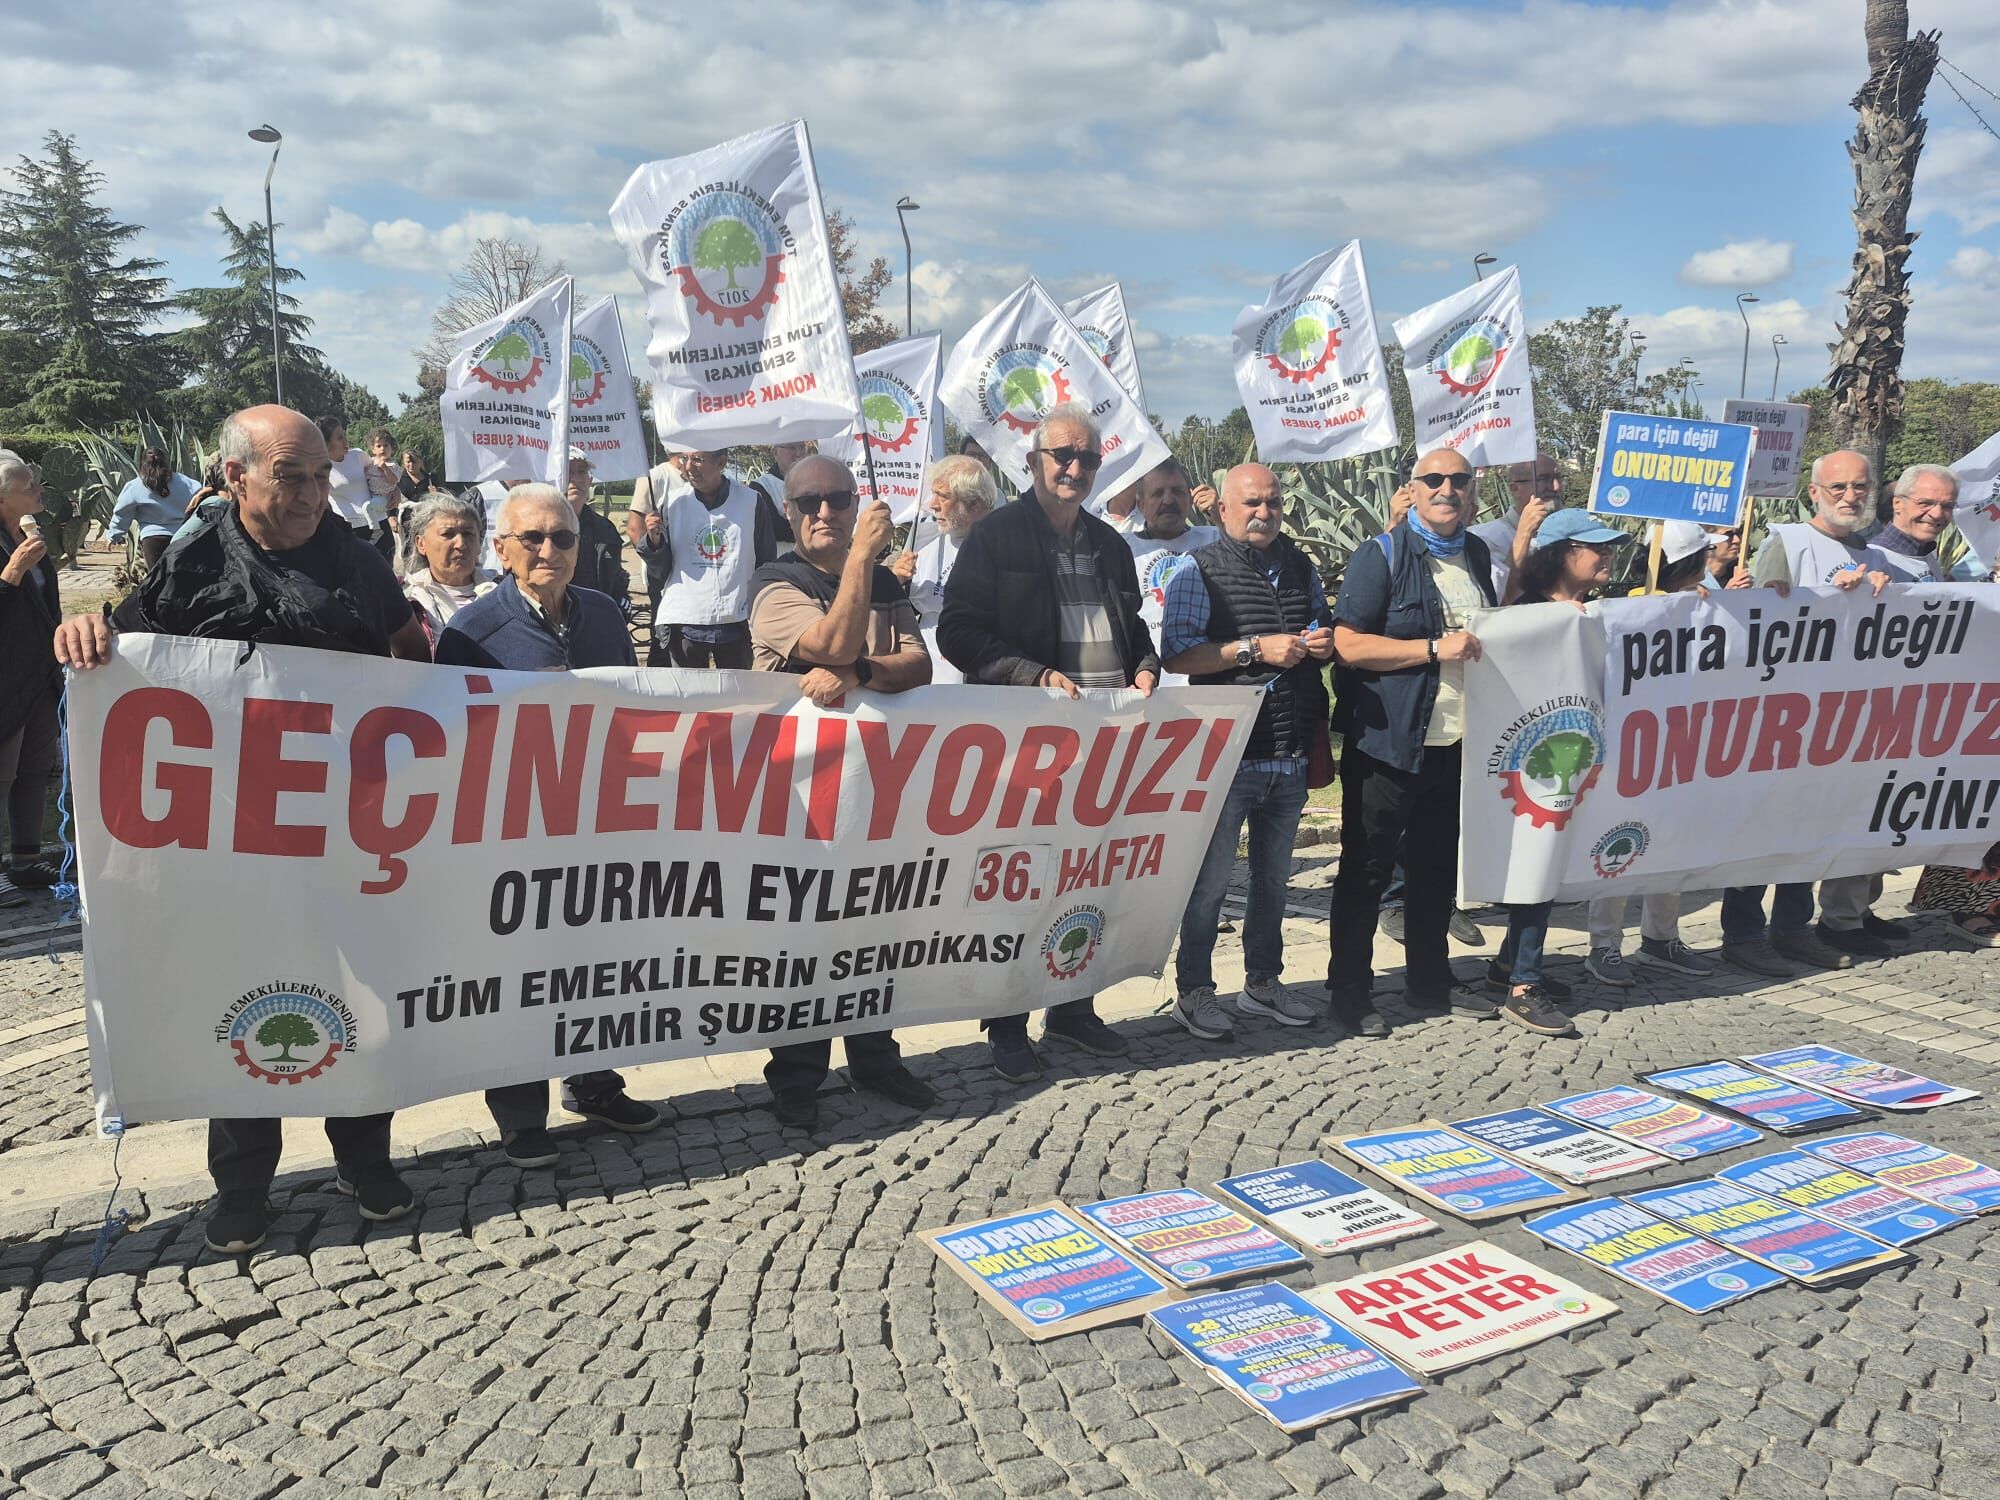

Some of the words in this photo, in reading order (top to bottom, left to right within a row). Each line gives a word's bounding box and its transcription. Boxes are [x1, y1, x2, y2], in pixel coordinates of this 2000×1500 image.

[1736, 409, 1753, 424] para
[1754, 408, 1768, 425] için
[1769, 410, 1787, 427] değil
[1616, 424, 1650, 443] para
[1653, 423, 1680, 449] için
[1683, 427, 1720, 452] değil
[1756, 431, 1794, 450] RUMUZ
[1611, 450, 1735, 489] ONURUMUZ
[1772, 455, 1790, 475] İÇİN!
[1692, 487, 1729, 516] İÇİN!
[1621, 622, 1726, 696] para
[1746, 607, 1837, 682] için
[1853, 598, 1976, 669] değil
[1487, 744, 1506, 778] TÜM
[1502, 693, 1588, 742] EMEKLİLERİN
[1615, 682, 2000, 800] ONURUMUZ
[99, 672, 1236, 895] GEÇİNEMİYORUZ!
[1554, 799, 1571, 808] 2017
[1868, 766, 1998, 848] İÇİN!
[489, 860, 723, 937] OTURMA
[746, 846, 950, 923] EYLEMİ!
[974, 850, 1042, 903] 36.
[1055, 832, 1166, 899] HAFTA
[397, 975, 501, 1030] TÜM
[519, 945, 817, 1010] EMEKLİLERİN
[830, 930, 1026, 982] SENDİKASI
[214, 1012, 235, 1043] TÜM
[230, 979, 327, 1014] EMEKLİLERİN
[325, 993, 359, 1053] SENDİKASI
[554, 1001, 681, 1058] İZMİR
[698, 978, 894, 1046] ŞUBELERİ
[273, 1065, 297, 1073] 2017
[1232, 1171, 1294, 1189] EMEKLİYE
[1242, 1182, 1285, 1196] AÇLIK,
[1103, 1194, 1182, 1214] ZENGİNİ
[1253, 1184, 1313, 1202] YANDAŞA
[1106, 1209, 1156, 1224] DAHA
[1300, 1208, 1326, 1218] Bu
[1323, 1196, 1373, 1212] yağma
[1339, 1204, 1388, 1220] düzeni
[1131, 1226, 1208, 1249] DÜZENE
[1197, 1216, 1253, 1234] SON!
[1341, 1212, 1404, 1232] yıkılacak
[944, 1236, 992, 1258] BU
[979, 1215, 1076, 1249] DEVRAN
[1542, 1224, 1598, 1246] BU
[965, 1248, 1032, 1275] BÖYLE
[1017, 1231, 1100, 1262] GİTMEZ!
[990, 1264, 1057, 1287] KÖTÜLÜĞÜN
[1335, 1252, 1507, 1315] ARTIK
[1060, 1291, 1083, 1300] TÜM
[1085, 1284, 1136, 1302] SENDİKASI
[1174, 1303, 1200, 1314] TÜM
[1198, 1288, 1264, 1310] EMEKLİLERİN
[1184, 1318, 1222, 1334] 28
[1217, 1301, 1292, 1326] YAŞINDA
[1201, 1300, 1255, 1317] SENDİKASI
[1365, 1274, 1560, 1339] YETER
[1199, 1328, 1228, 1339] FON
[1246, 1332, 1278, 1345] TIR
[1416, 1347, 1441, 1359] TÜM
[1442, 1326, 1509, 1353] EMEKLİLERİN
[1507, 1311, 1561, 1332] SENDİKASI
[1331, 1350, 1374, 1366] YOK!
